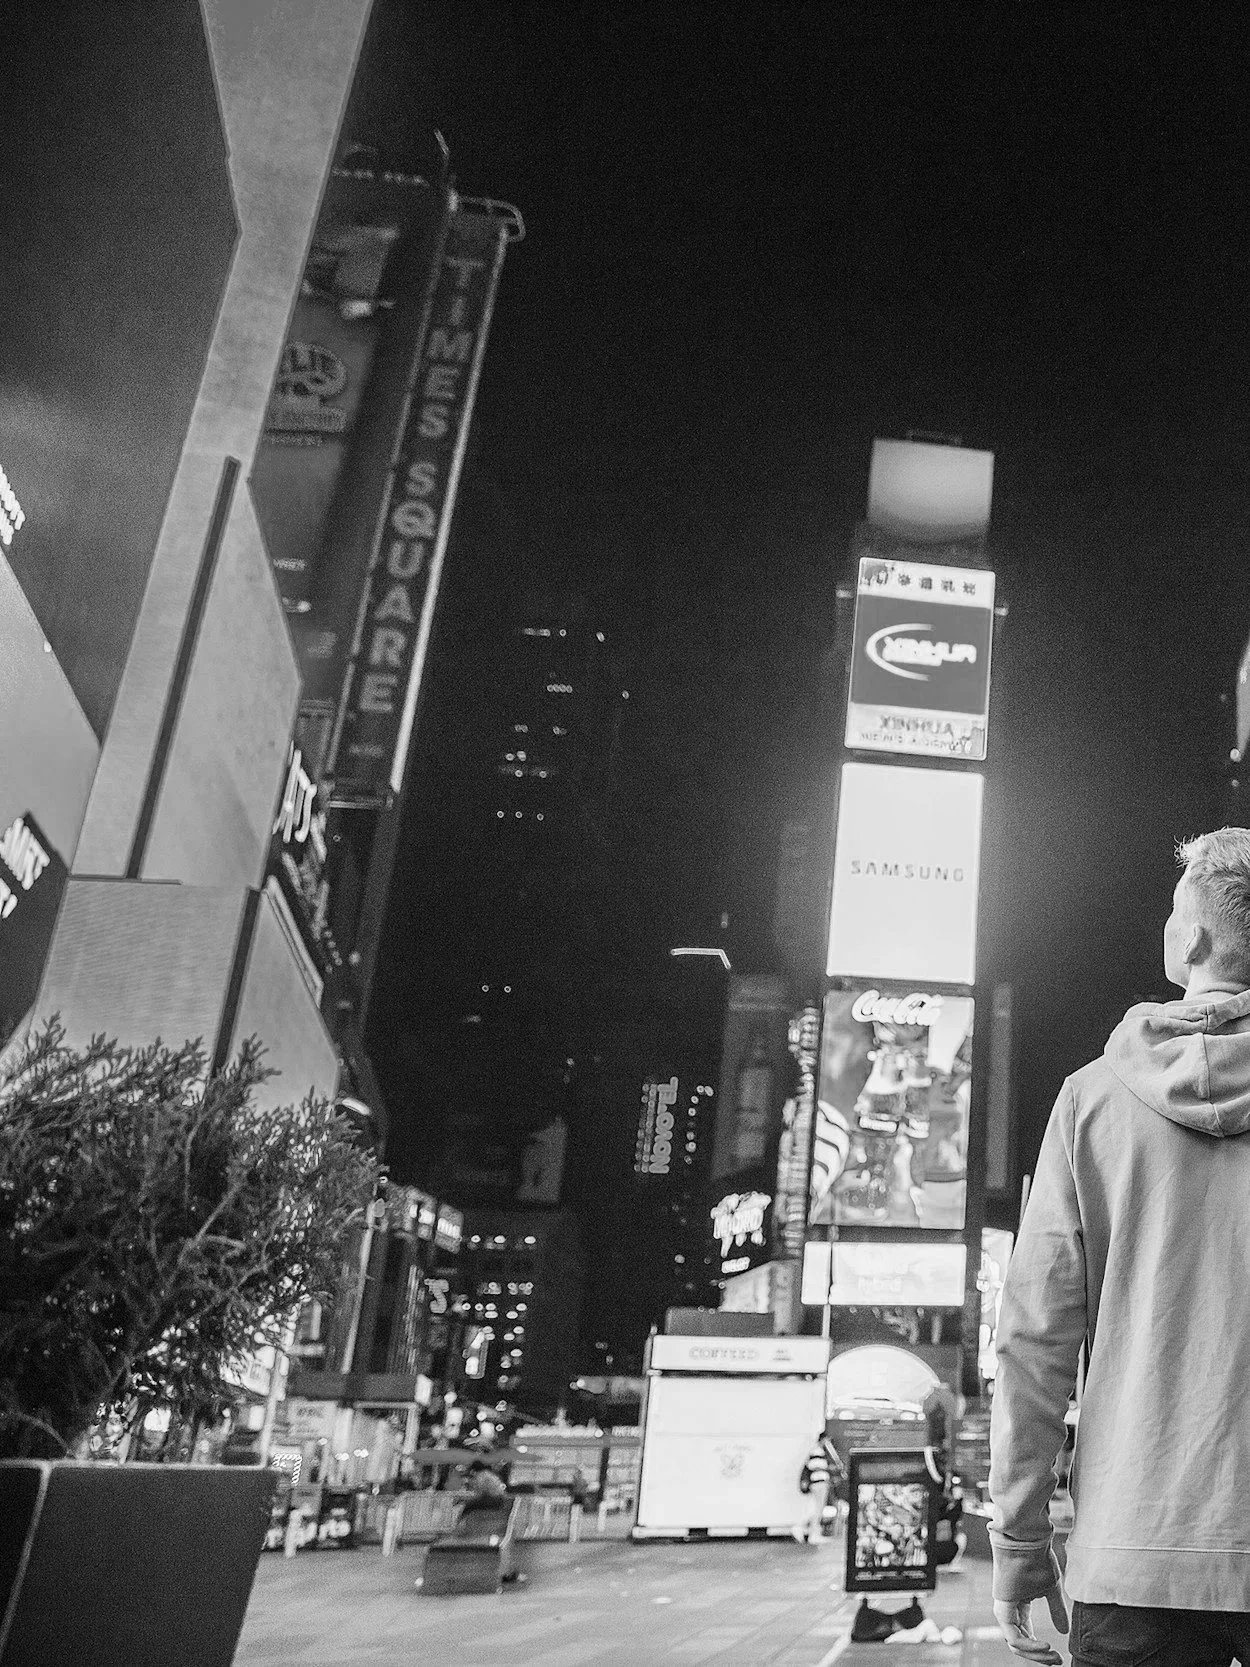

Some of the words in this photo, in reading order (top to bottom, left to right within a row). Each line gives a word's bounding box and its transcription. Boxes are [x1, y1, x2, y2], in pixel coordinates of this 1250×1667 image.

[418, 255, 486, 438] TIMES
[359, 460, 437, 712] SQUARE
[850, 859, 965, 882] SAMSUNG
